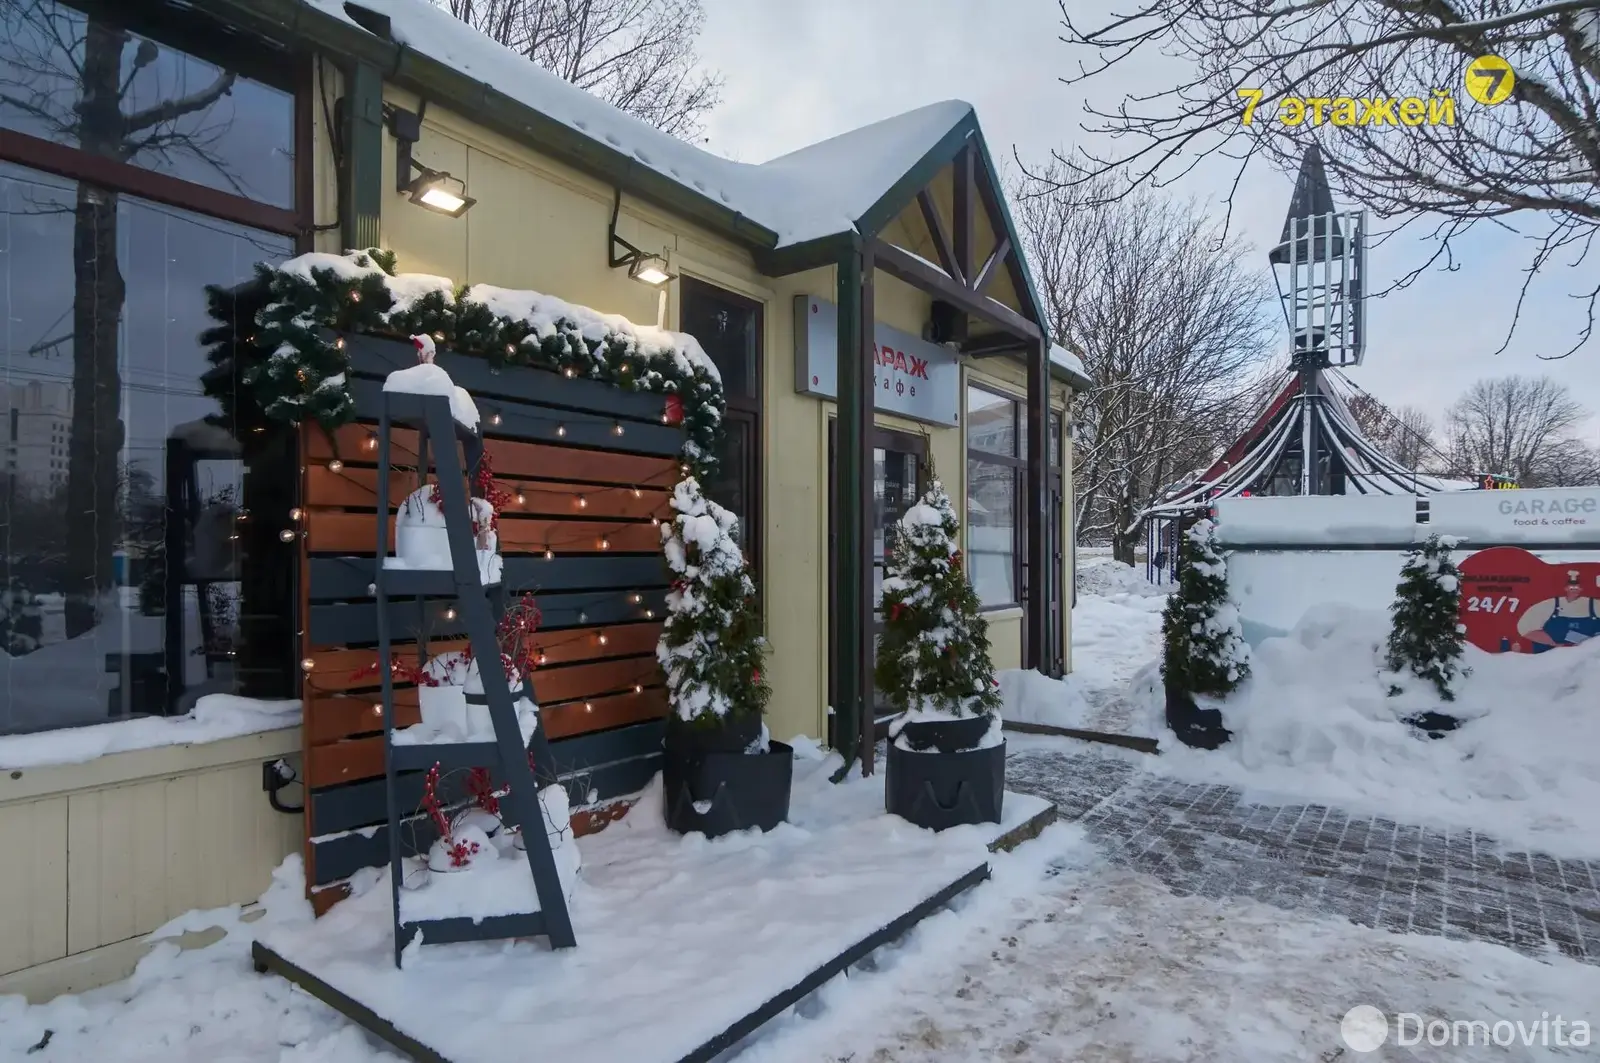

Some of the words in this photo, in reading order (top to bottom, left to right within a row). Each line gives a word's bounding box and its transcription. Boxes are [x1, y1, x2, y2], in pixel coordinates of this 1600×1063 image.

[1513, 518, 1538, 526] food
[1541, 518, 1549, 526] &
[1552, 517, 1586, 525] coffee
[1467, 596, 1520, 614] 24/7
